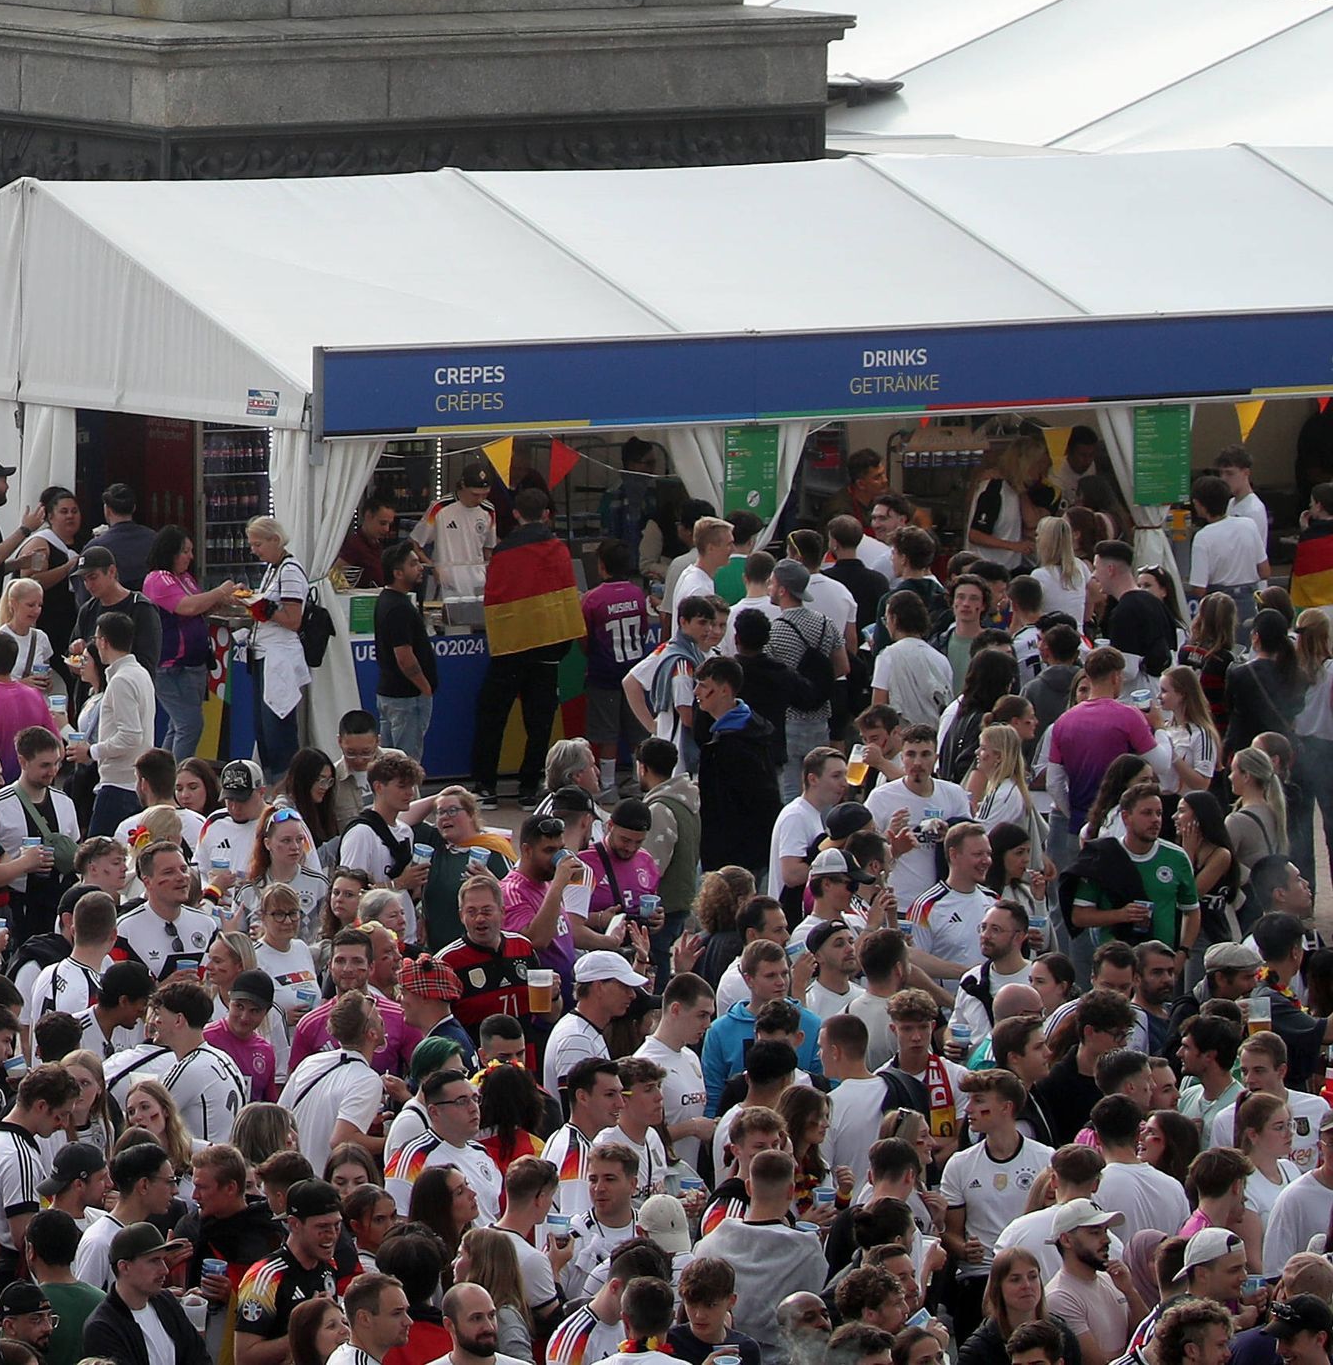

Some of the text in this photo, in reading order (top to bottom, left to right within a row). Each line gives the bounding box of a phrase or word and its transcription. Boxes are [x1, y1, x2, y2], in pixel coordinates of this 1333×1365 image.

[863, 349, 927, 368] DRINKS
[434, 366, 506, 385] CREPES
[850, 372, 940, 395] GETRÄNKE
[435, 391, 504, 412] CRÊPES
[607, 600, 638, 615] MUSIALA
[605, 615, 643, 663] 10
